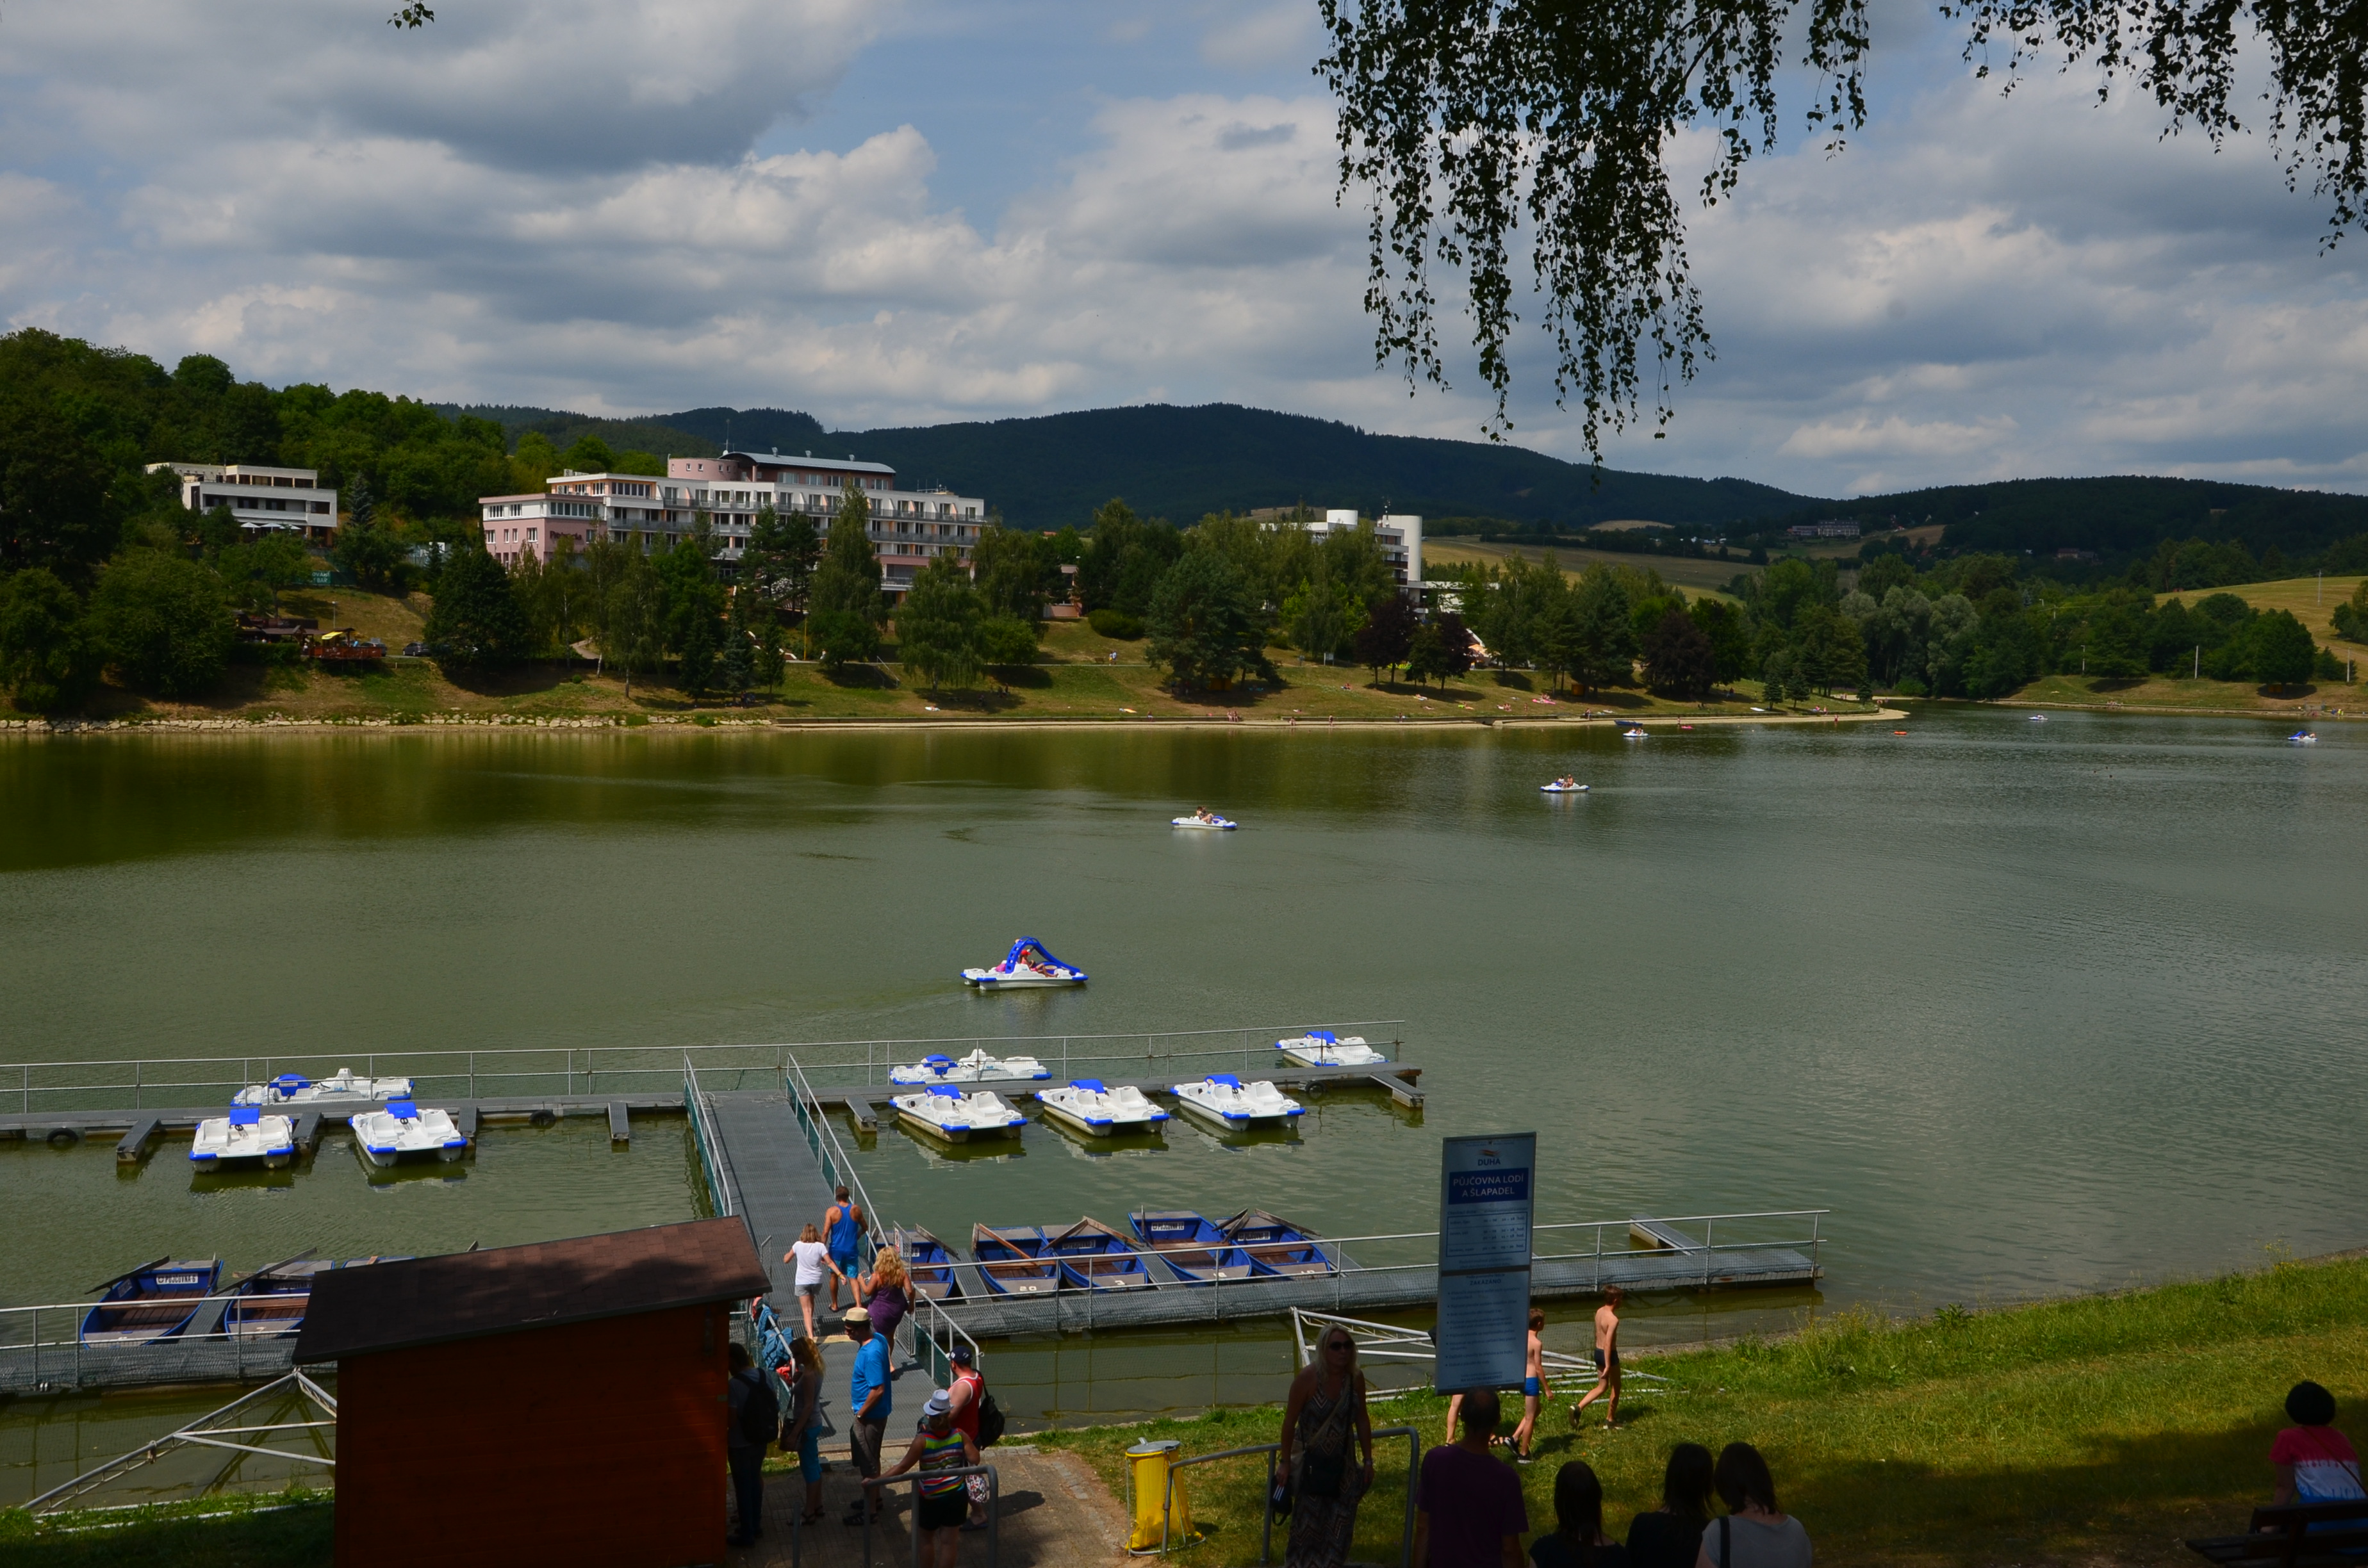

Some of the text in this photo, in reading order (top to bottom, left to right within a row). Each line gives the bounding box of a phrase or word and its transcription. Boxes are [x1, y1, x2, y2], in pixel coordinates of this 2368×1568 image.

[1453, 1173, 1524, 1186] PŮJČOVNA LODÍ
[1470, 1187, 1515, 1196] ŠLAPADEL
